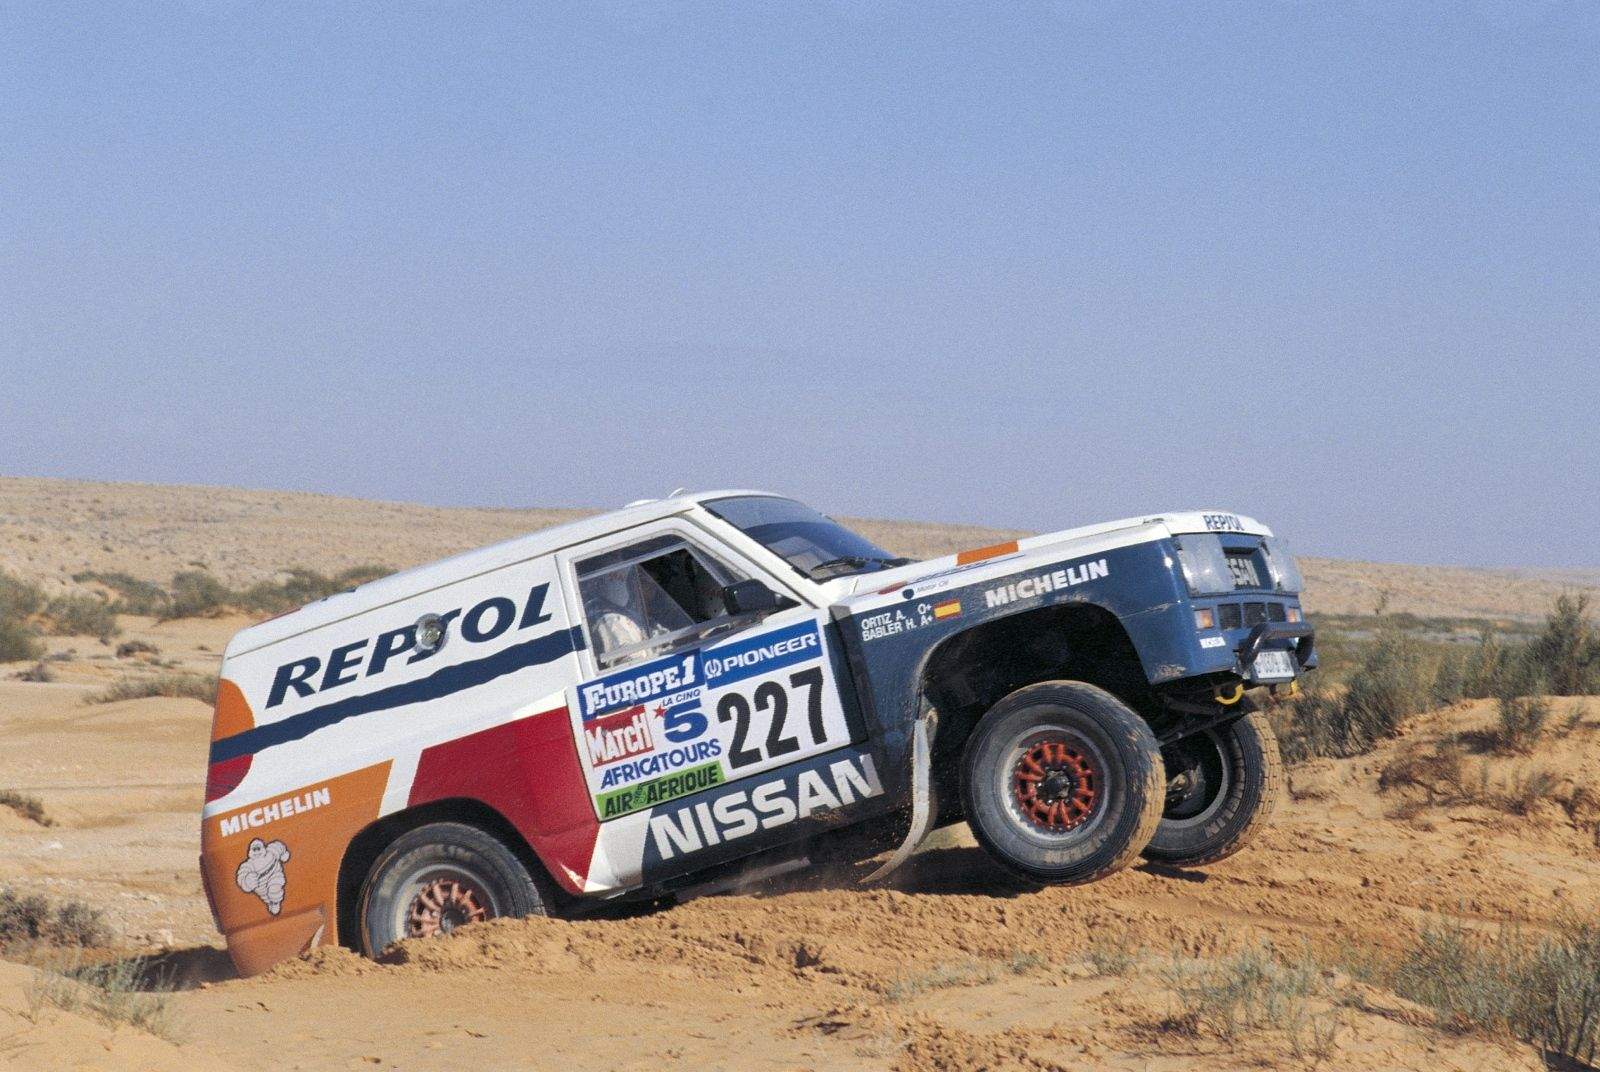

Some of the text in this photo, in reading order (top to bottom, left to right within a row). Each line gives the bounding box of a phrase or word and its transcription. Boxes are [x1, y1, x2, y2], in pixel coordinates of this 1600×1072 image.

[985, 559, 1109, 608] MICHELIN
[265, 582, 552, 709] REPSOL
[861, 612, 892, 630] ORTIZ
[723, 632, 819, 673] PIONEER
[585, 712, 652, 765] MATCH
[664, 700, 708, 743] 5
[716, 665, 828, 770] 227
[600, 737, 722, 790] AFRICATOURS
[219, 787, 331, 838] MICHELIN
[605, 763, 719, 818] AIR AFRIQUE
[650, 753, 885, 861] NISSAN
